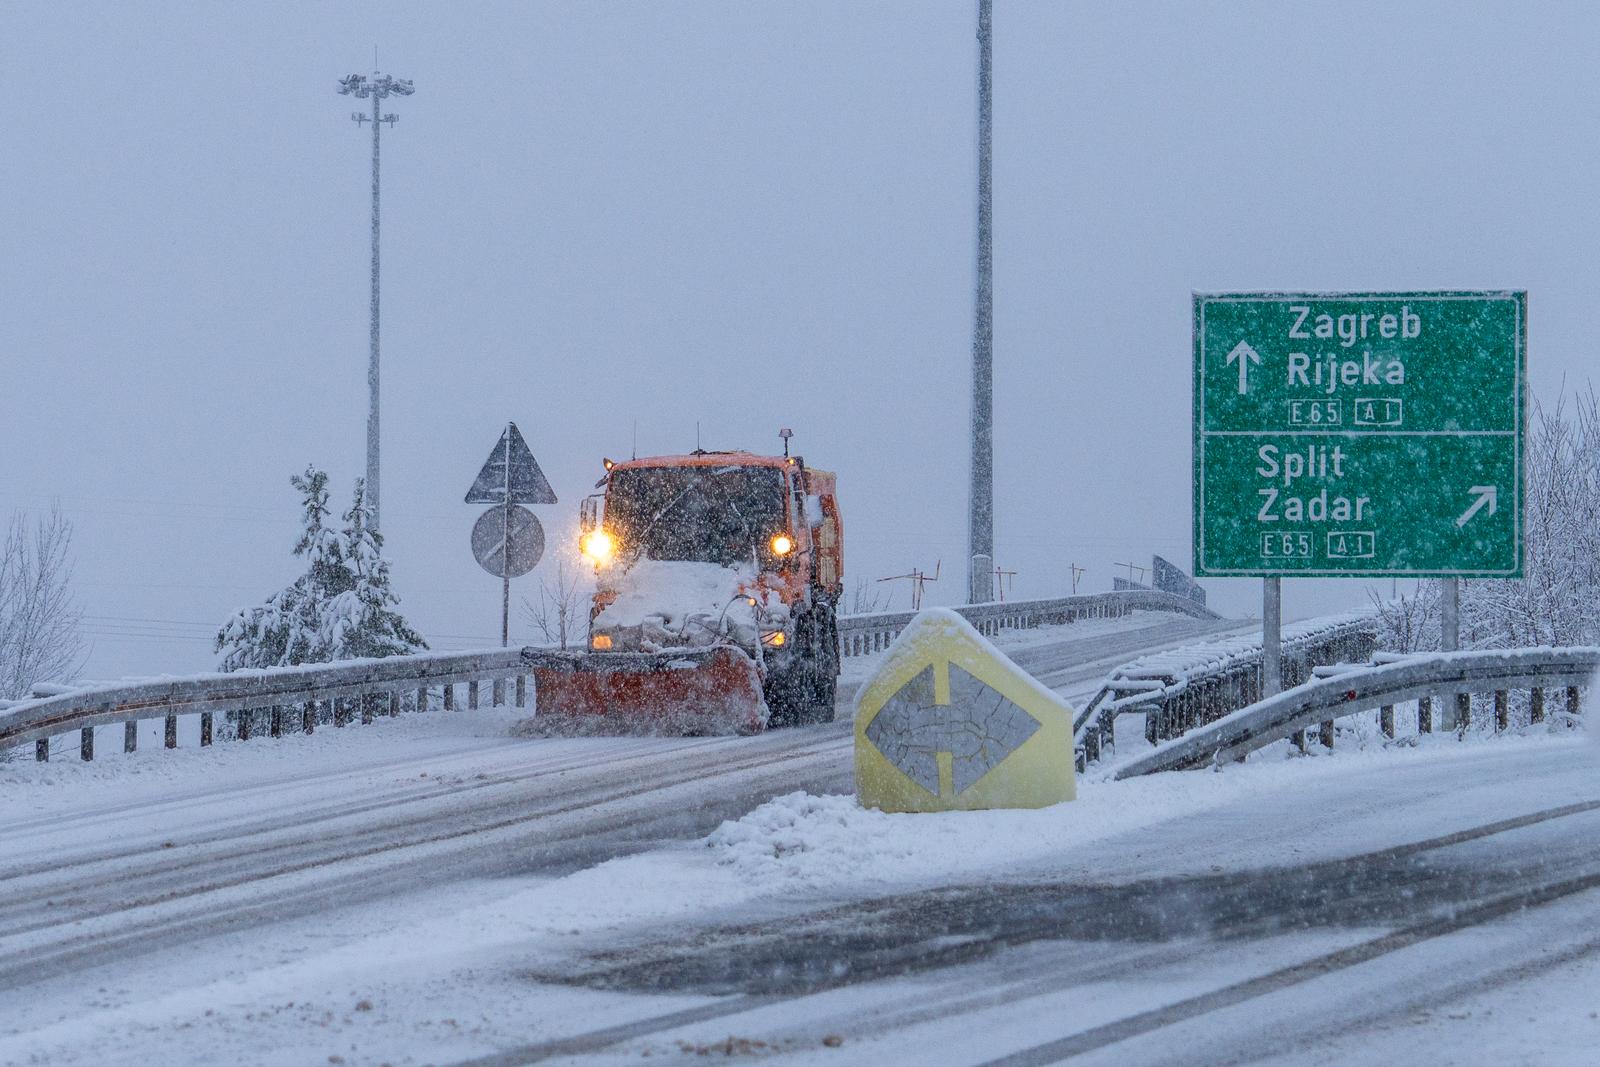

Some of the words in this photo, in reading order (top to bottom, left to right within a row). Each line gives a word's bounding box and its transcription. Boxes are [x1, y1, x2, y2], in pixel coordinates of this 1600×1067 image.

[1288, 306, 1421, 347] Zagreb
[1288, 352, 1405, 394] Rijeka
[1256, 445, 1345, 487] Split
[1257, 489, 1370, 521] Zadar
